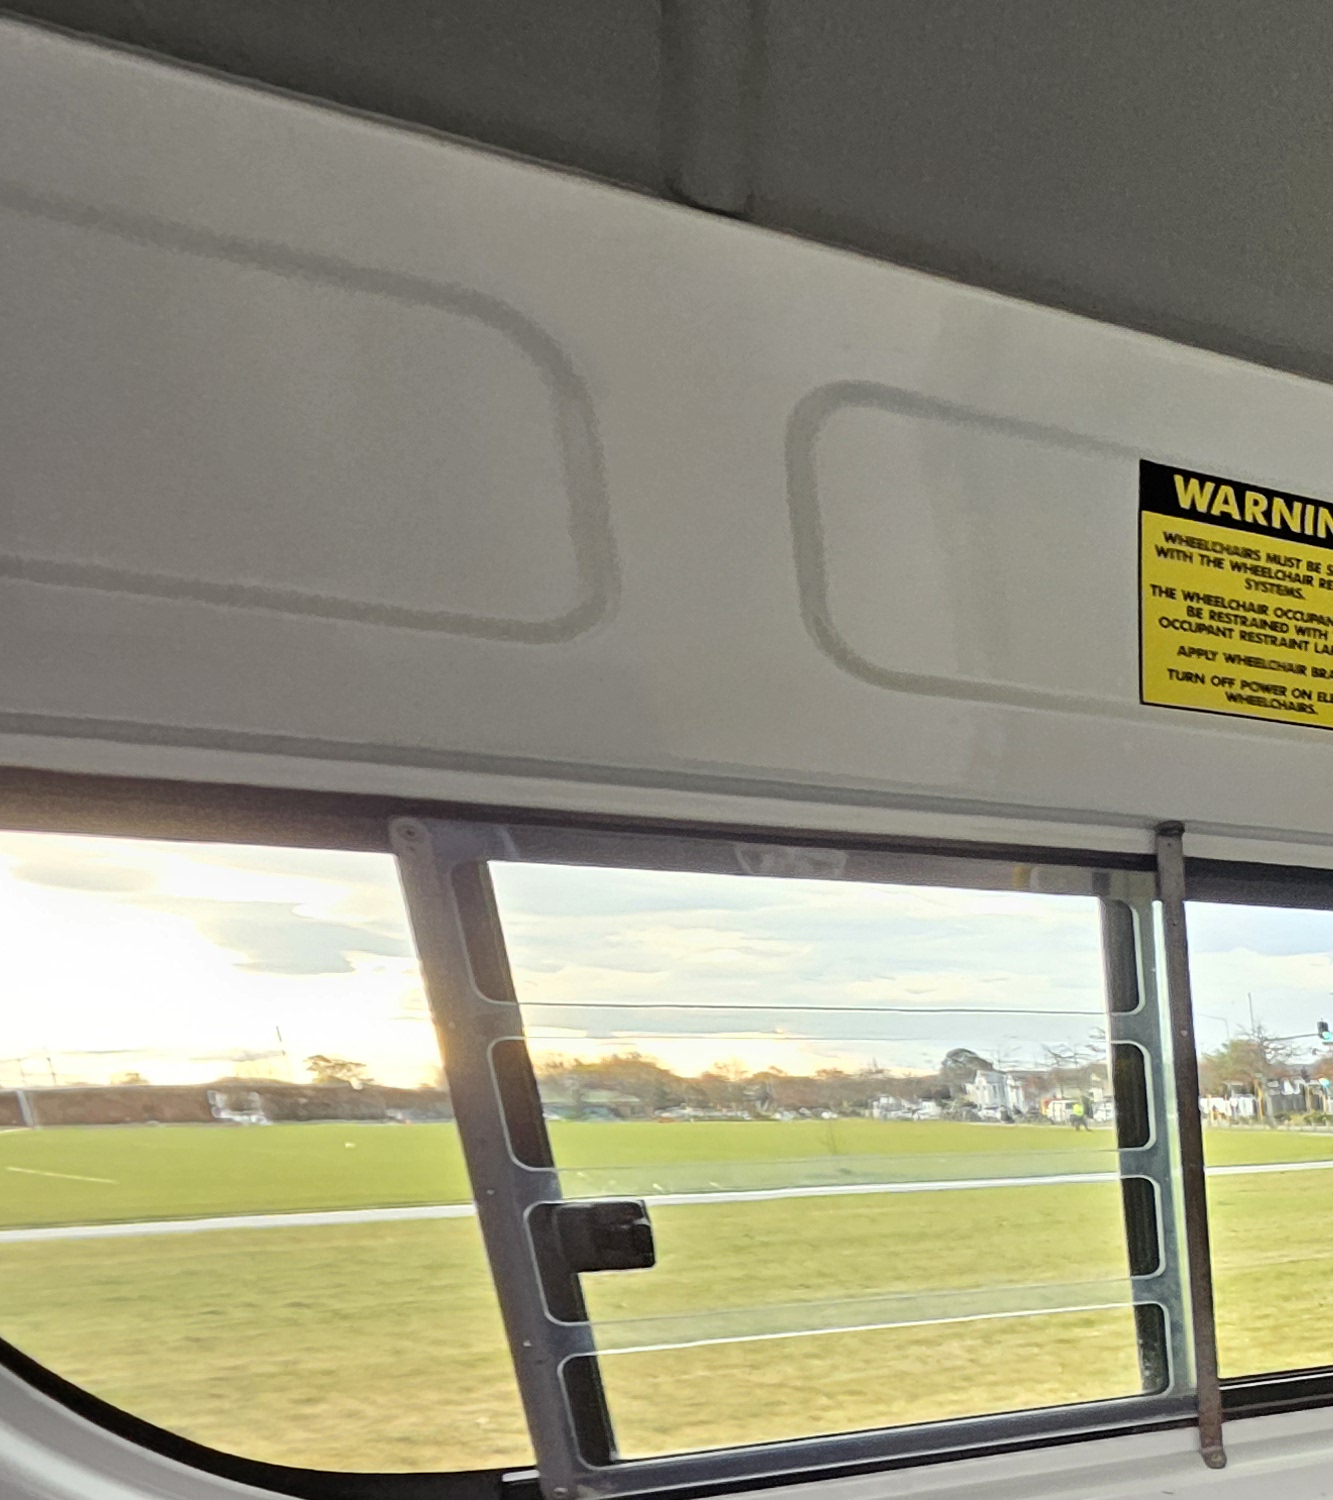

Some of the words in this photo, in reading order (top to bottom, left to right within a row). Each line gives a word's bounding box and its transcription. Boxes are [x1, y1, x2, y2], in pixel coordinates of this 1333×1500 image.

[1155, 544, 1194, 564] WITH
[1199, 554, 1225, 570] THE
[1229, 560, 1314, 587] WHEELCHAIR
[1163, 531, 1261, 562] WHEELCHAIRS
[1266, 553, 1303, 570] MUST
[1306, 560, 1322, 574] BE
[1150, 583, 1177, 600] THE
[1181, 589, 1270, 616] WHEELCHAIR
[1158, 616, 1234, 640] OCCUPANT
[1239, 629, 1310, 652] RESTRAINT
[1186, 605, 1204, 620] BE
[1209, 609, 1290, 634] RESTRAINED
[1294, 624, 1328, 641] WITH
[1177, 645, 1219, 662] APPLY
[1222, 651, 1307, 676] WHEELCHAIR
[1167, 668, 1206, 685] TURN
[1210, 675, 1237, 689] OFF
[1240, 679, 1288, 697] POWER
[1291, 687, 1313, 700] ON
